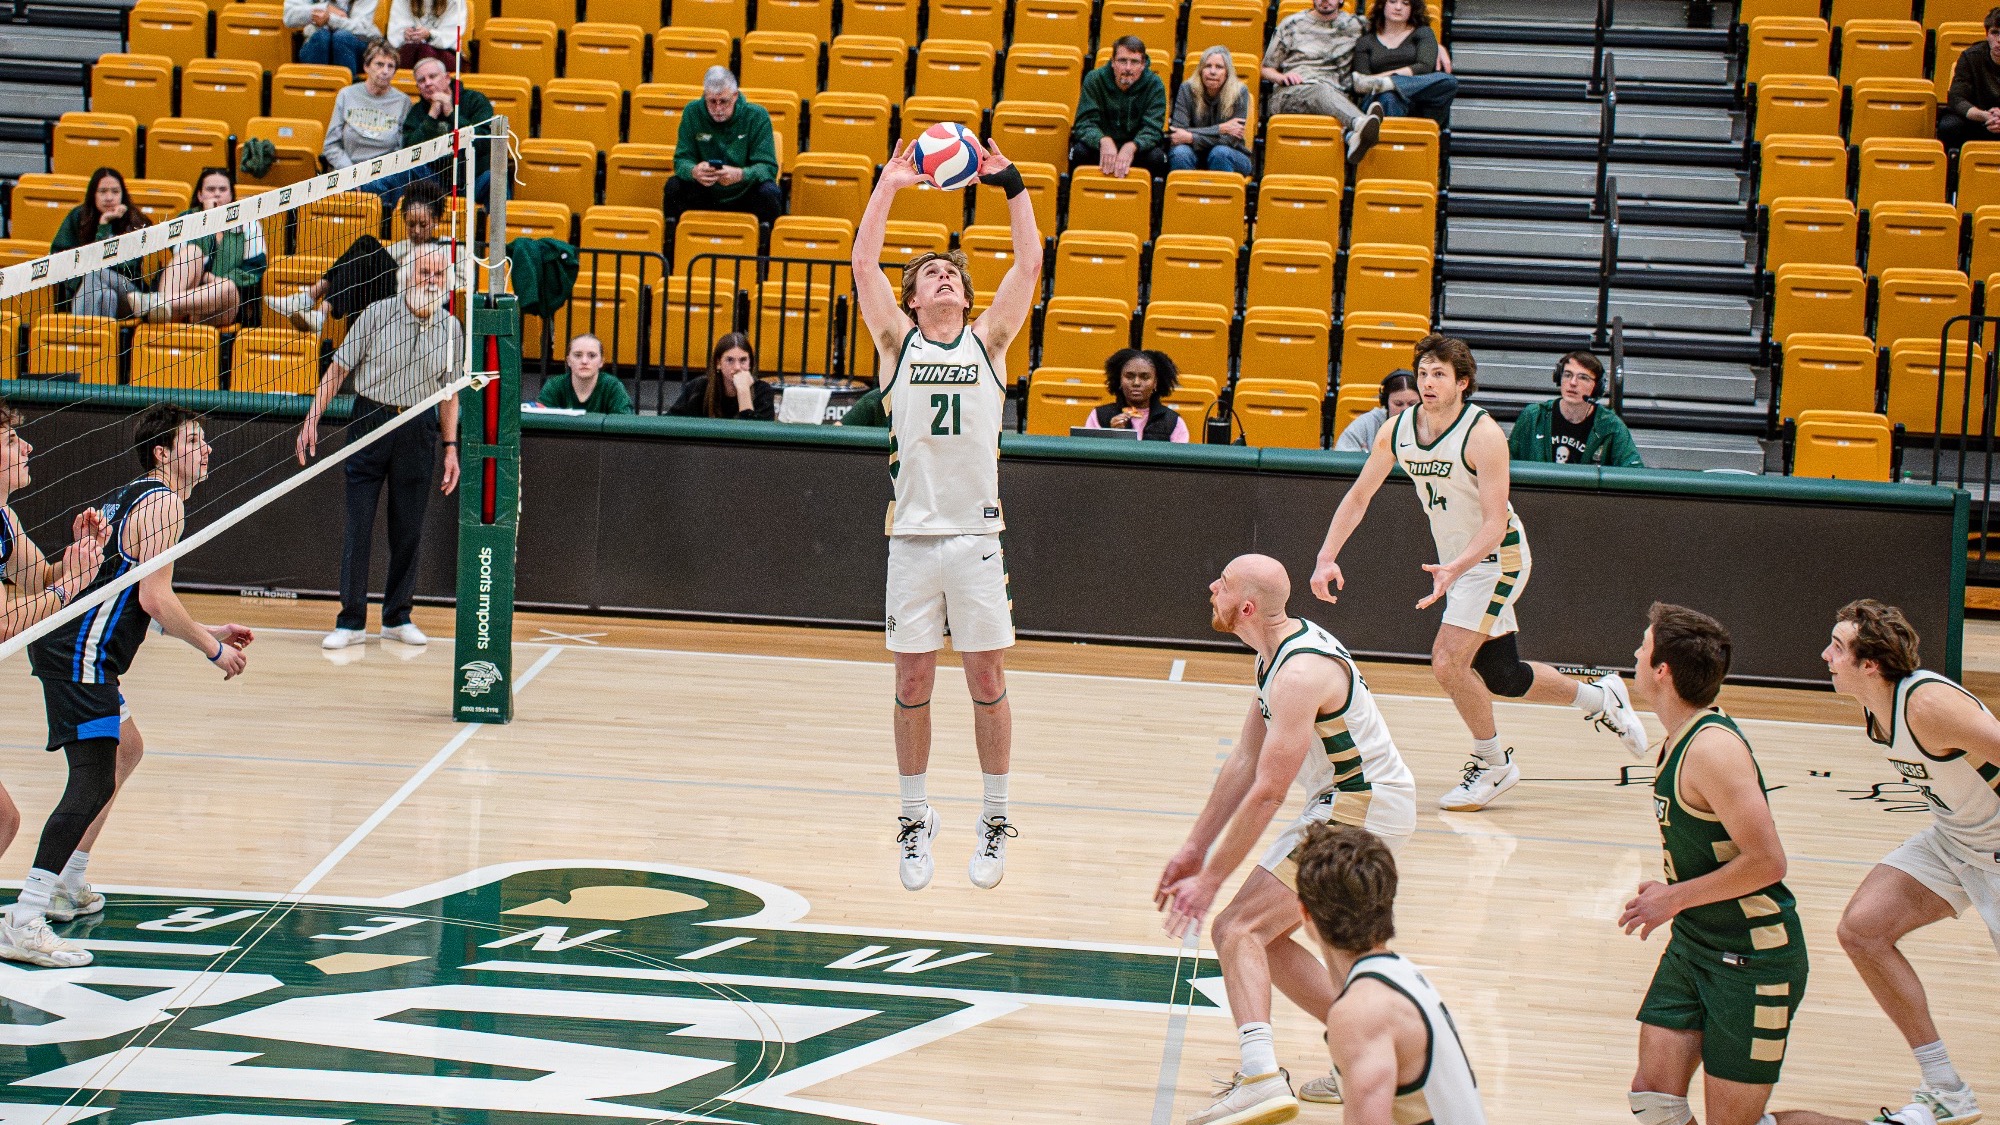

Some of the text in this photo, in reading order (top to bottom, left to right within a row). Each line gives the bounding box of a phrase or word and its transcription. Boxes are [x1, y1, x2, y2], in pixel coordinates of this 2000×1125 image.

[911, 364, 979, 384] MINERS
[930, 393, 961, 436] 21
[240, 590, 298, 598] DAKTRONICS
[476, 547, 492, 650] sports imports
[1891, 761, 1925, 778] NERS
[0, 903, 995, 974] MINER
